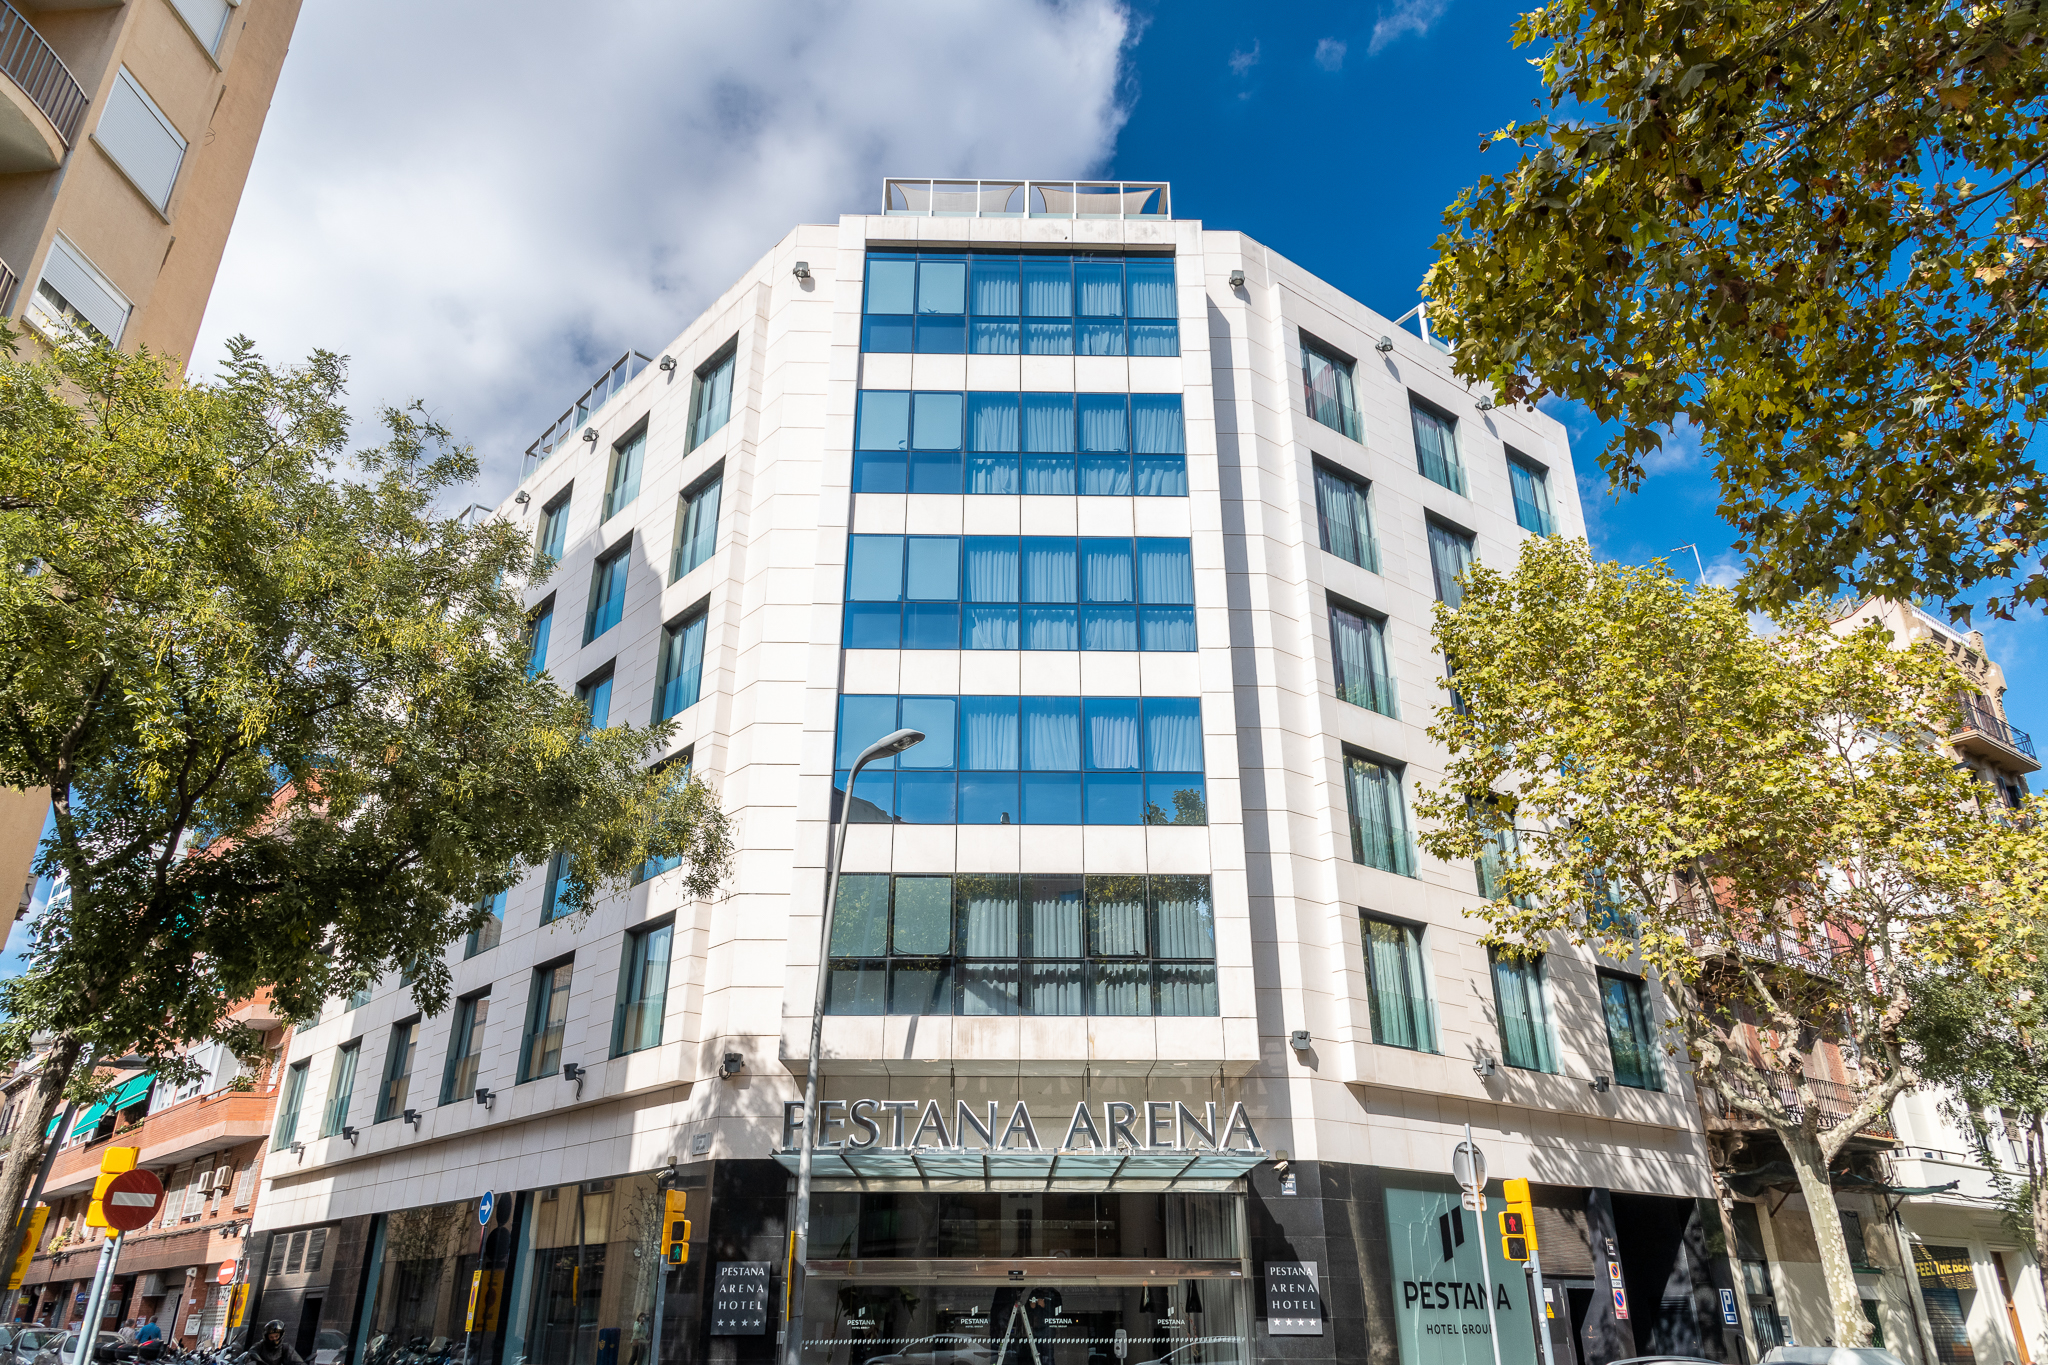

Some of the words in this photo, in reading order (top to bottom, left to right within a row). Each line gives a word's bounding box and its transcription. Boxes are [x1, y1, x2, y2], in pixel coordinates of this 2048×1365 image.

[782, 1099, 1041, 1151] PESTANA
[1060, 1100, 1264, 1152] ARENA
[721, 1267, 765, 1276] PESTANA
[1270, 1267, 1313, 1276] PESTANA
[1933, 1260, 1953, 1275] THE
[719, 1284, 764, 1293] ARENA
[1270, 1283, 1315, 1293] ARENA
[1403, 1281, 1512, 1310] PESTANA
[718, 1300, 763, 1310] HOTEL
[1272, 1300, 1316, 1310] HOTEL
[1426, 1324, 1459, 1335] HOTEL
